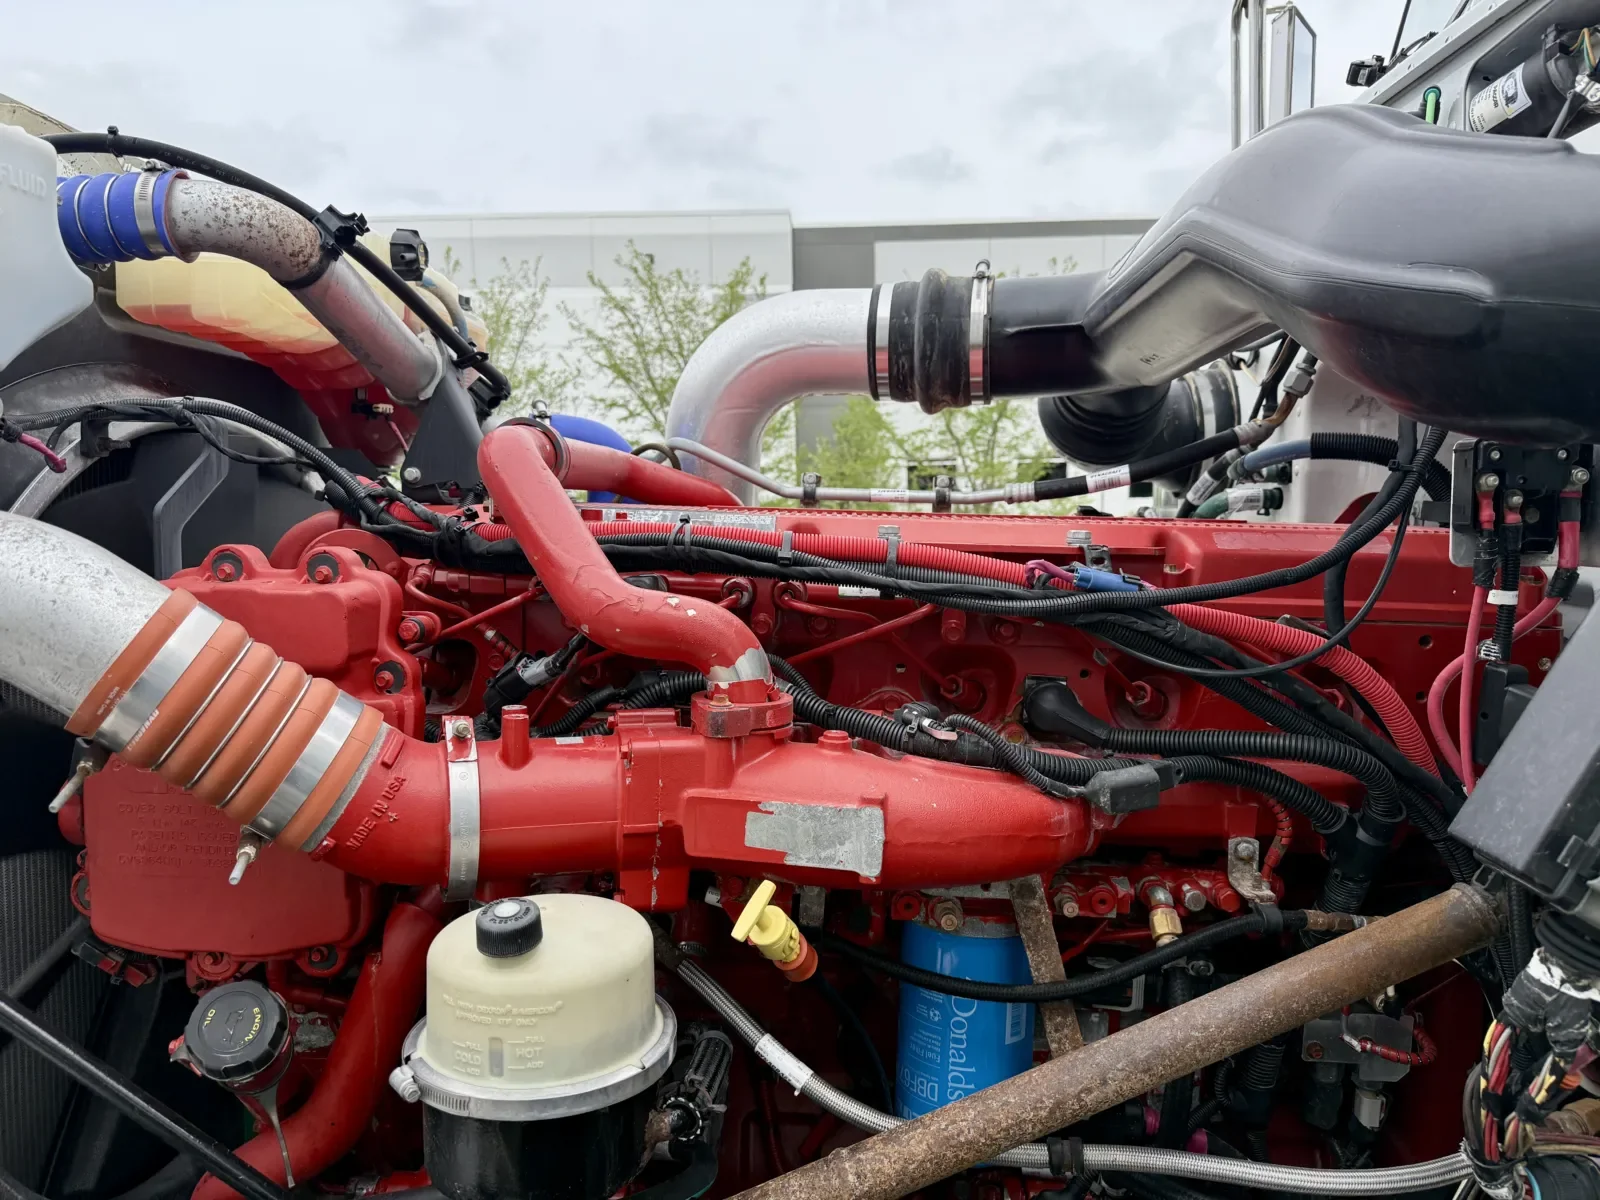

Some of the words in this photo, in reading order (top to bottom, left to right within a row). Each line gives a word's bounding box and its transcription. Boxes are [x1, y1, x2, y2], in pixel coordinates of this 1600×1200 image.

[118, 803, 156, 814] COVER
[346, 817, 377, 850] MADE
[371, 799, 389, 818] IN
[381, 776, 407, 800] USA
[241, 1007, 262, 1044] ENGIN
[947, 976, 979, 1101] Donalds
[455, 1049, 481, 1065] COLD
[516, 1047, 543, 1059] HOT
[526, 1061, 544, 1069] ADD
